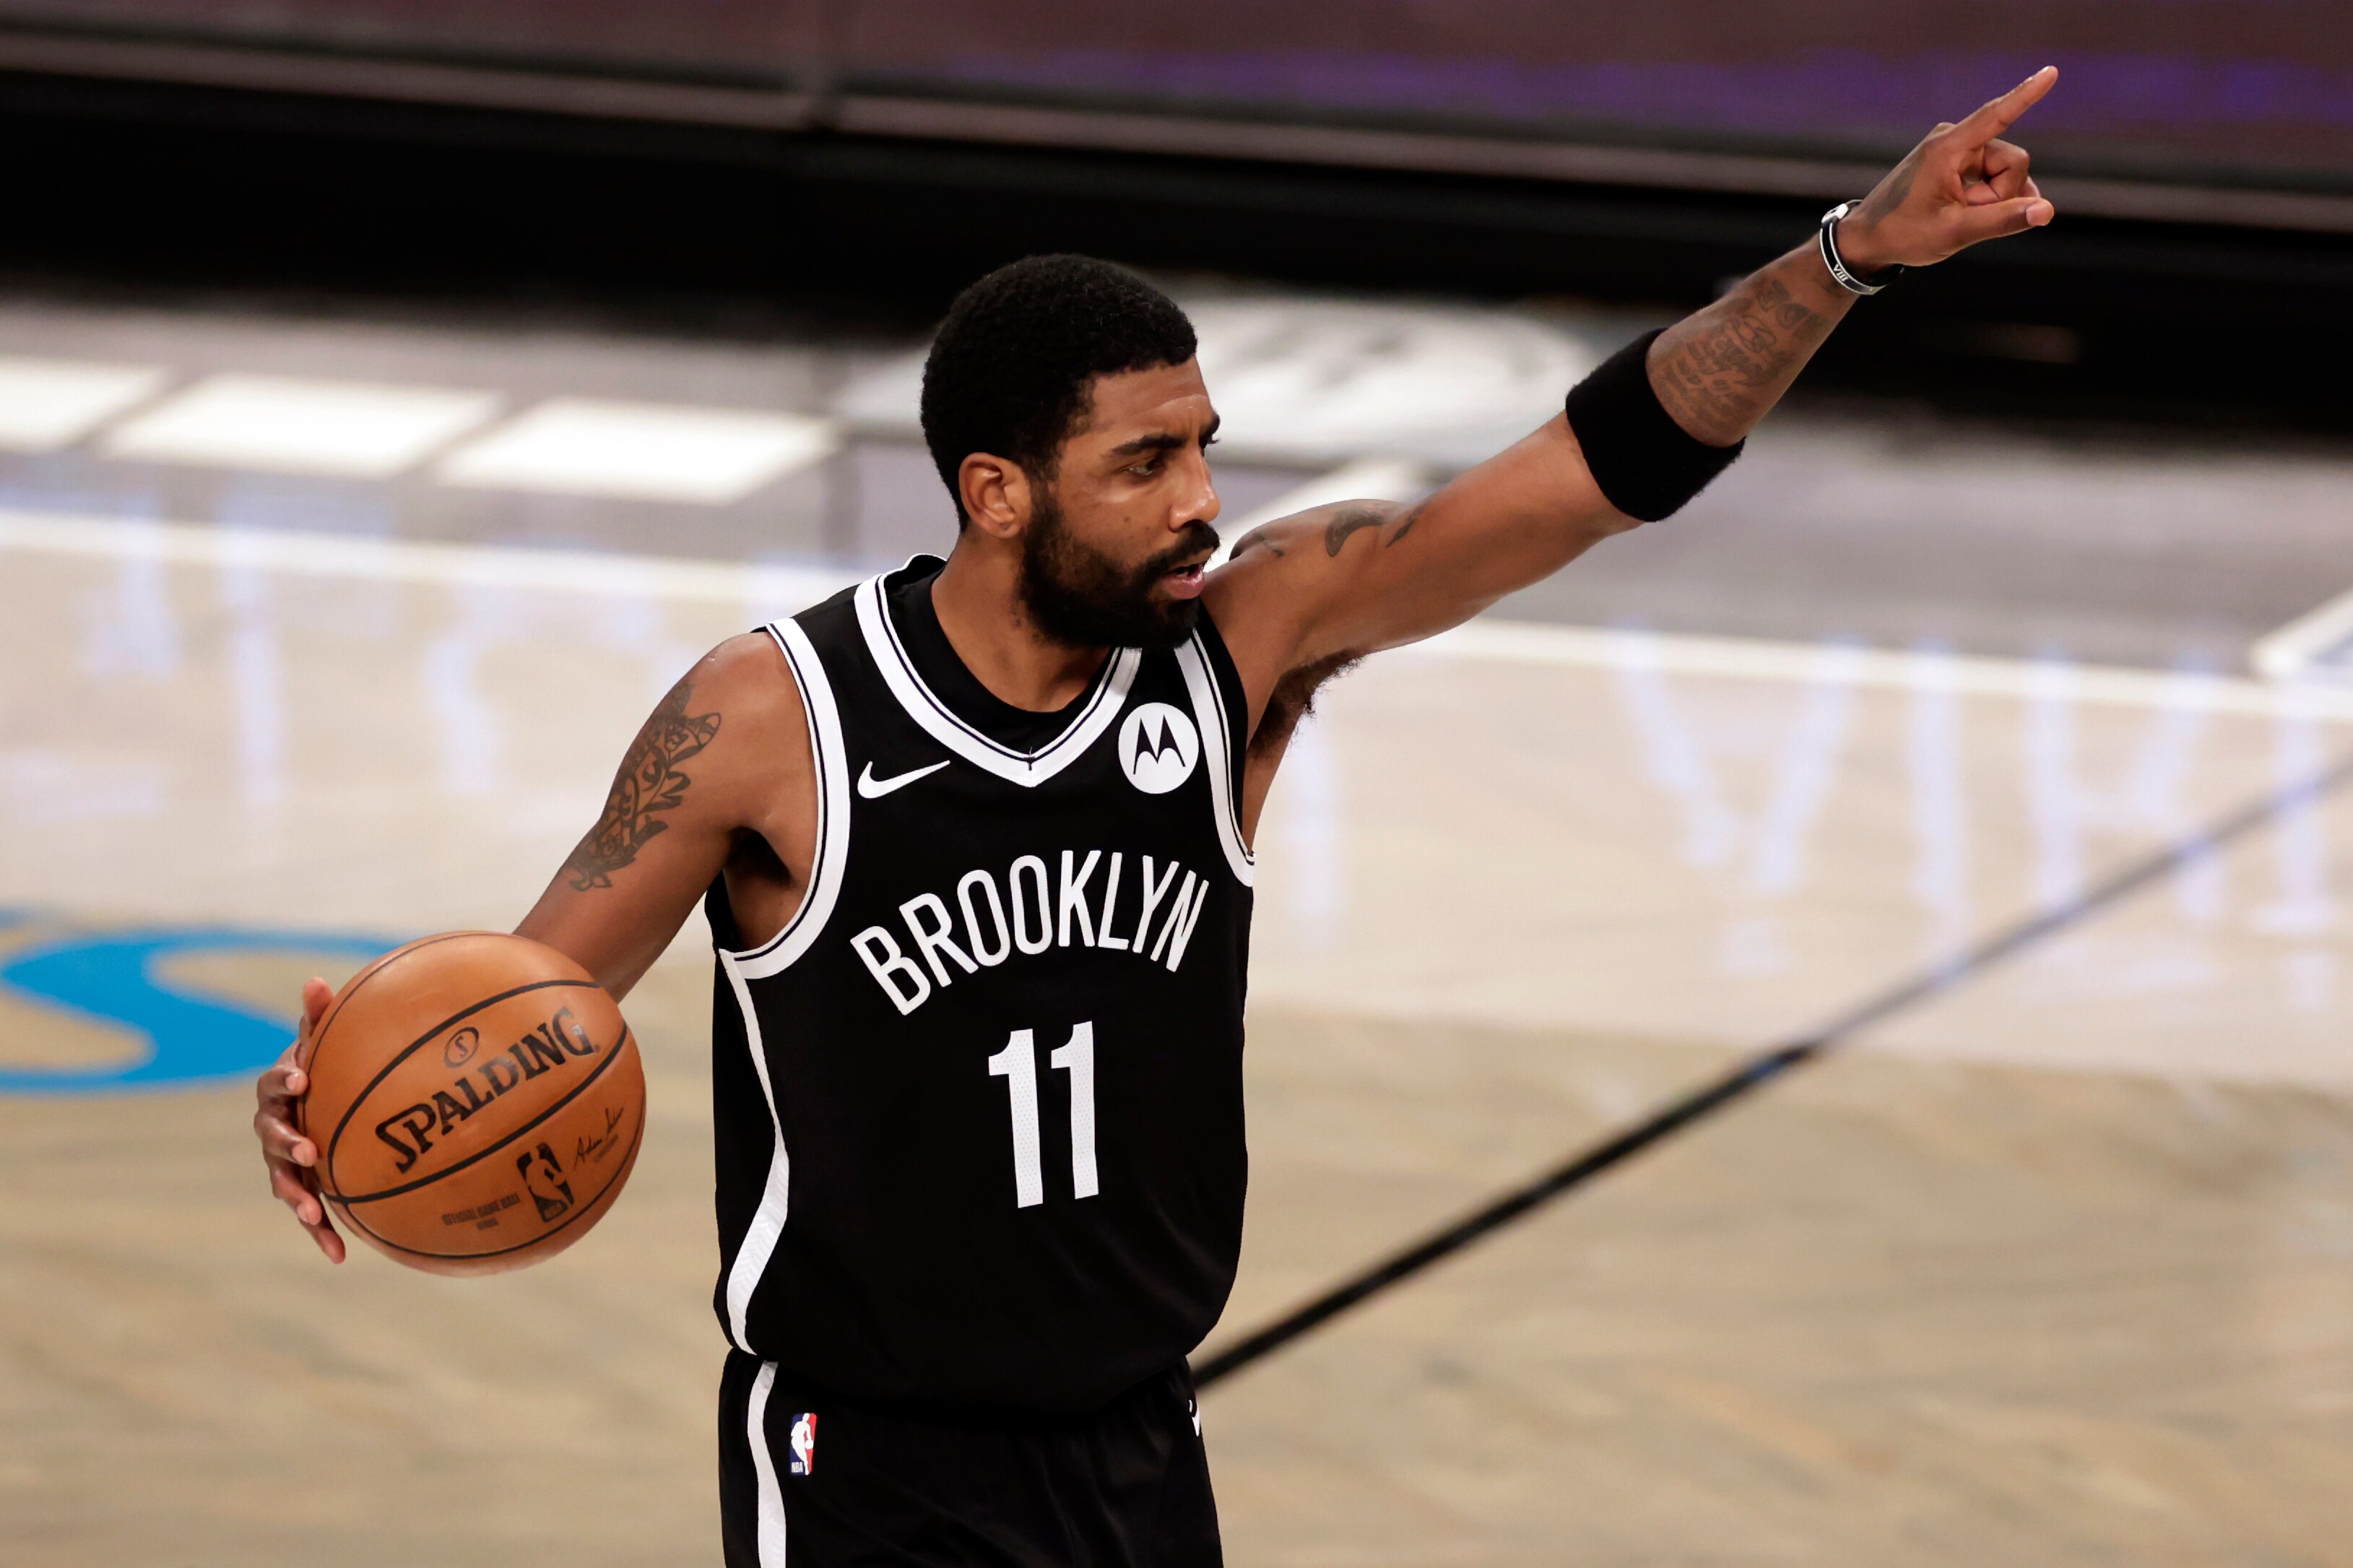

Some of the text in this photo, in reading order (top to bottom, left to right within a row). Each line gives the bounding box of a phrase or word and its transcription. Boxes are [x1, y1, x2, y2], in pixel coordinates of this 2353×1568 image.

[850, 850, 1209, 1015] BROOKLYN
[375, 1005, 594, 1174] SPALDING
[989, 1021, 1098, 1208] 11
[791, 1461, 803, 1473] NBA
